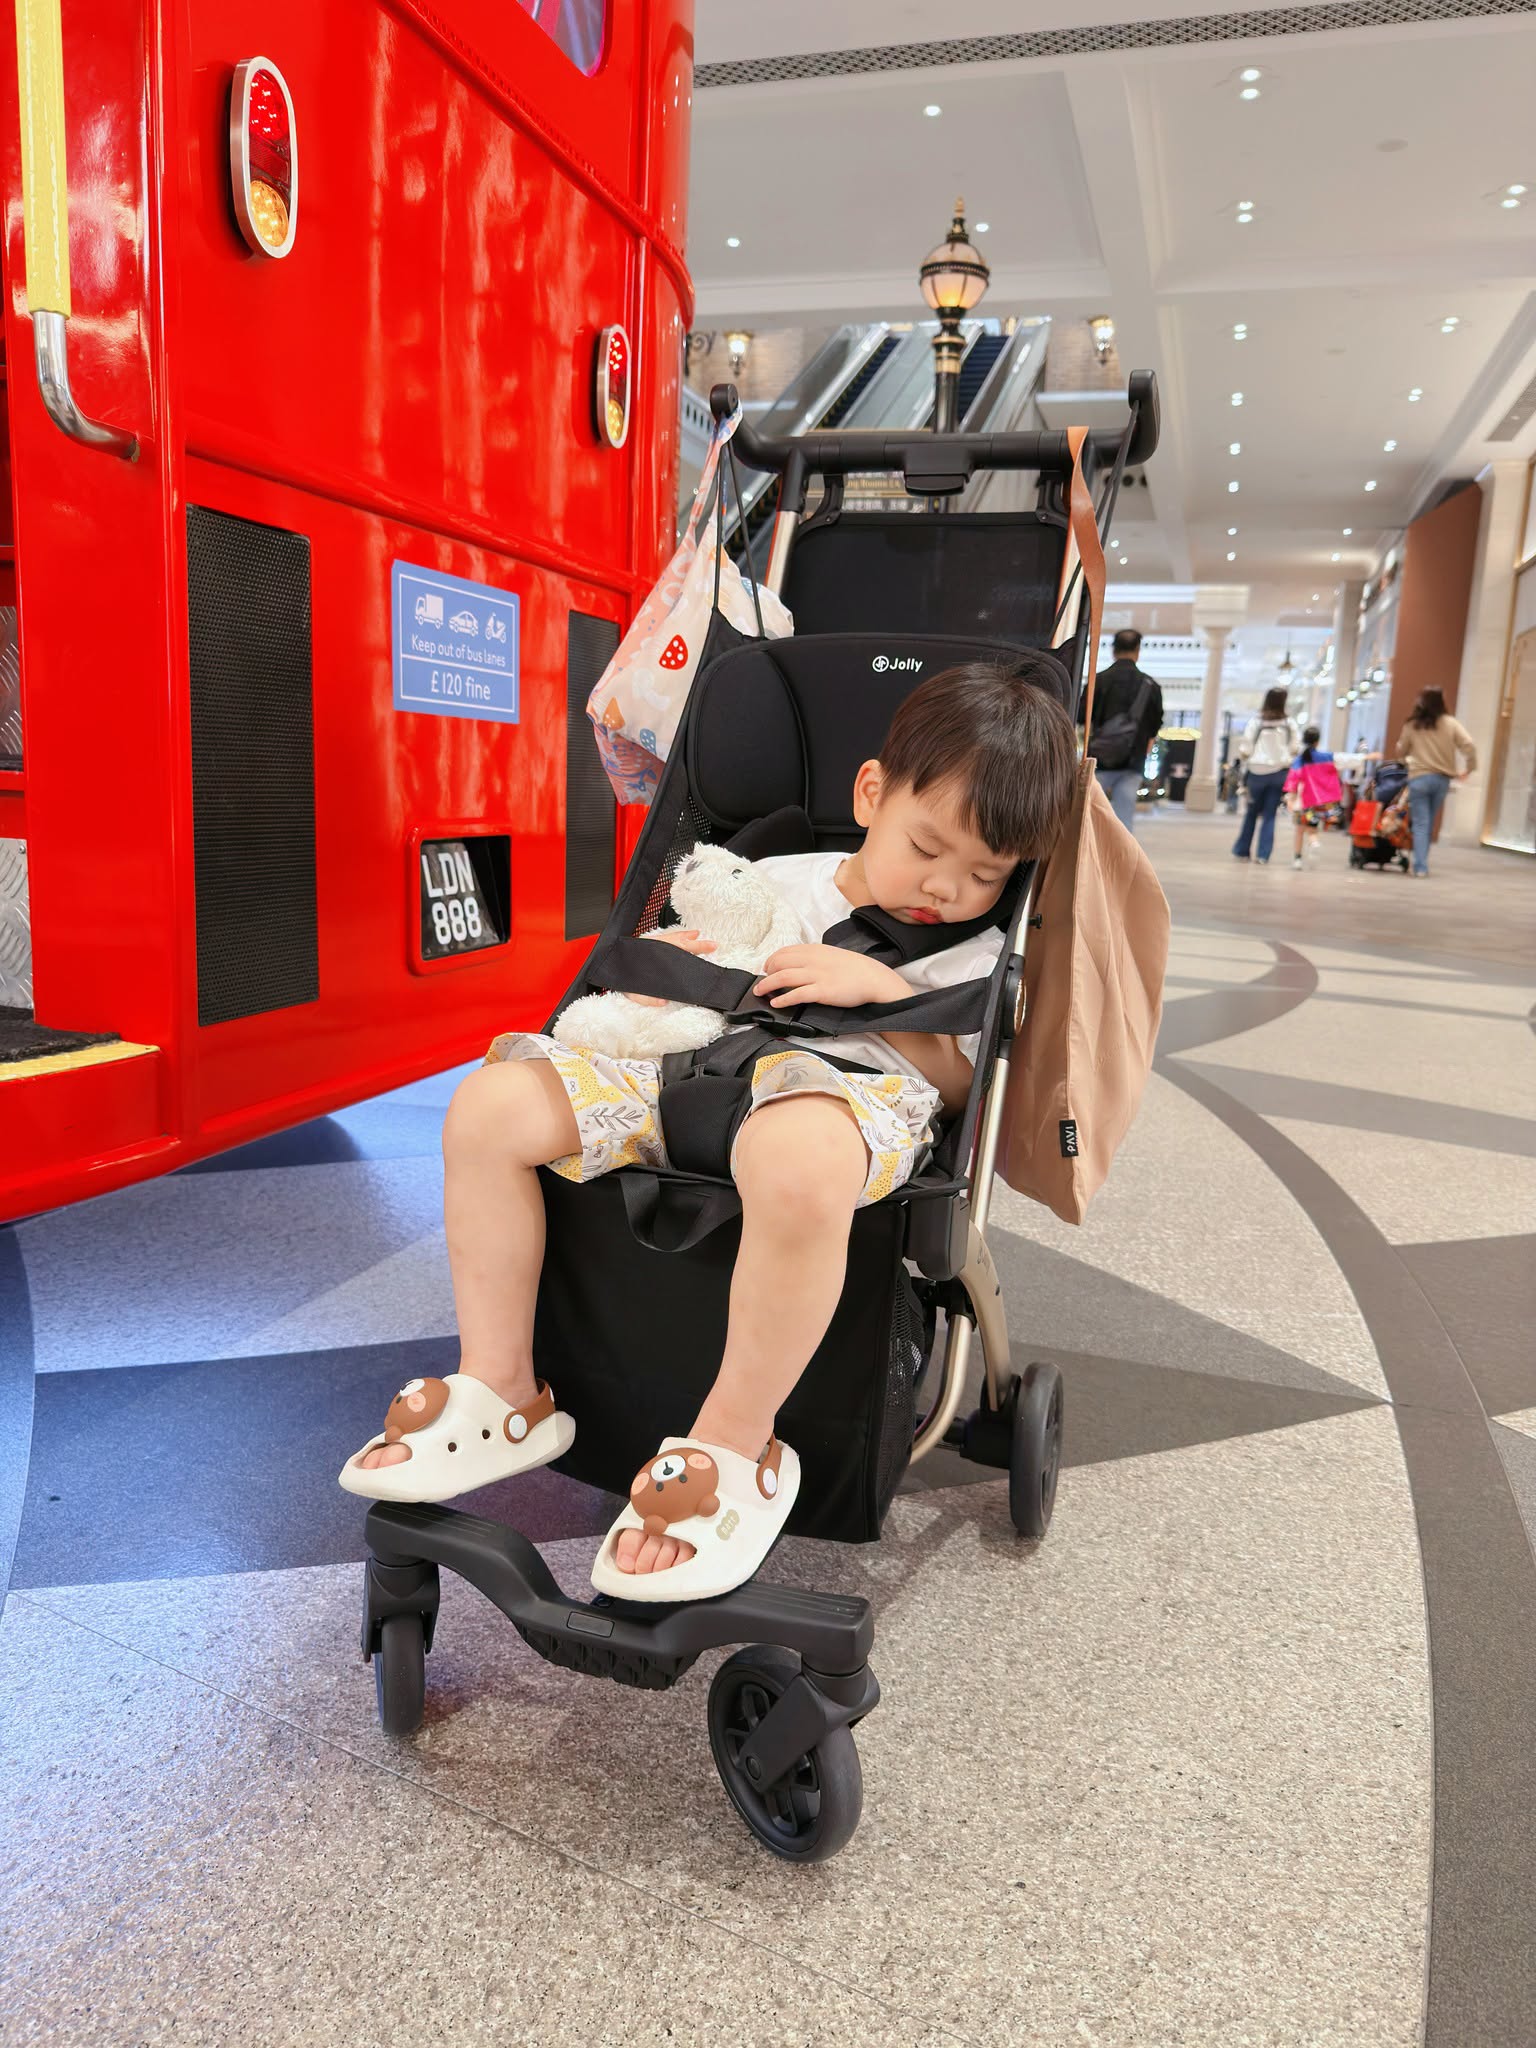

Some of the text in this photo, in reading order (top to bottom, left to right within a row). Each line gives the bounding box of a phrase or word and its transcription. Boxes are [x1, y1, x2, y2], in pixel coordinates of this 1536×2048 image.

[411, 634, 506, 667] Keep out of bus lanes
[889, 657, 923, 673] Jolly
[465, 676, 491, 701] fine
[422, 850, 475, 898] LDN
[432, 896, 482, 945] 888
[1065, 1126, 1076, 1153] PAVI
